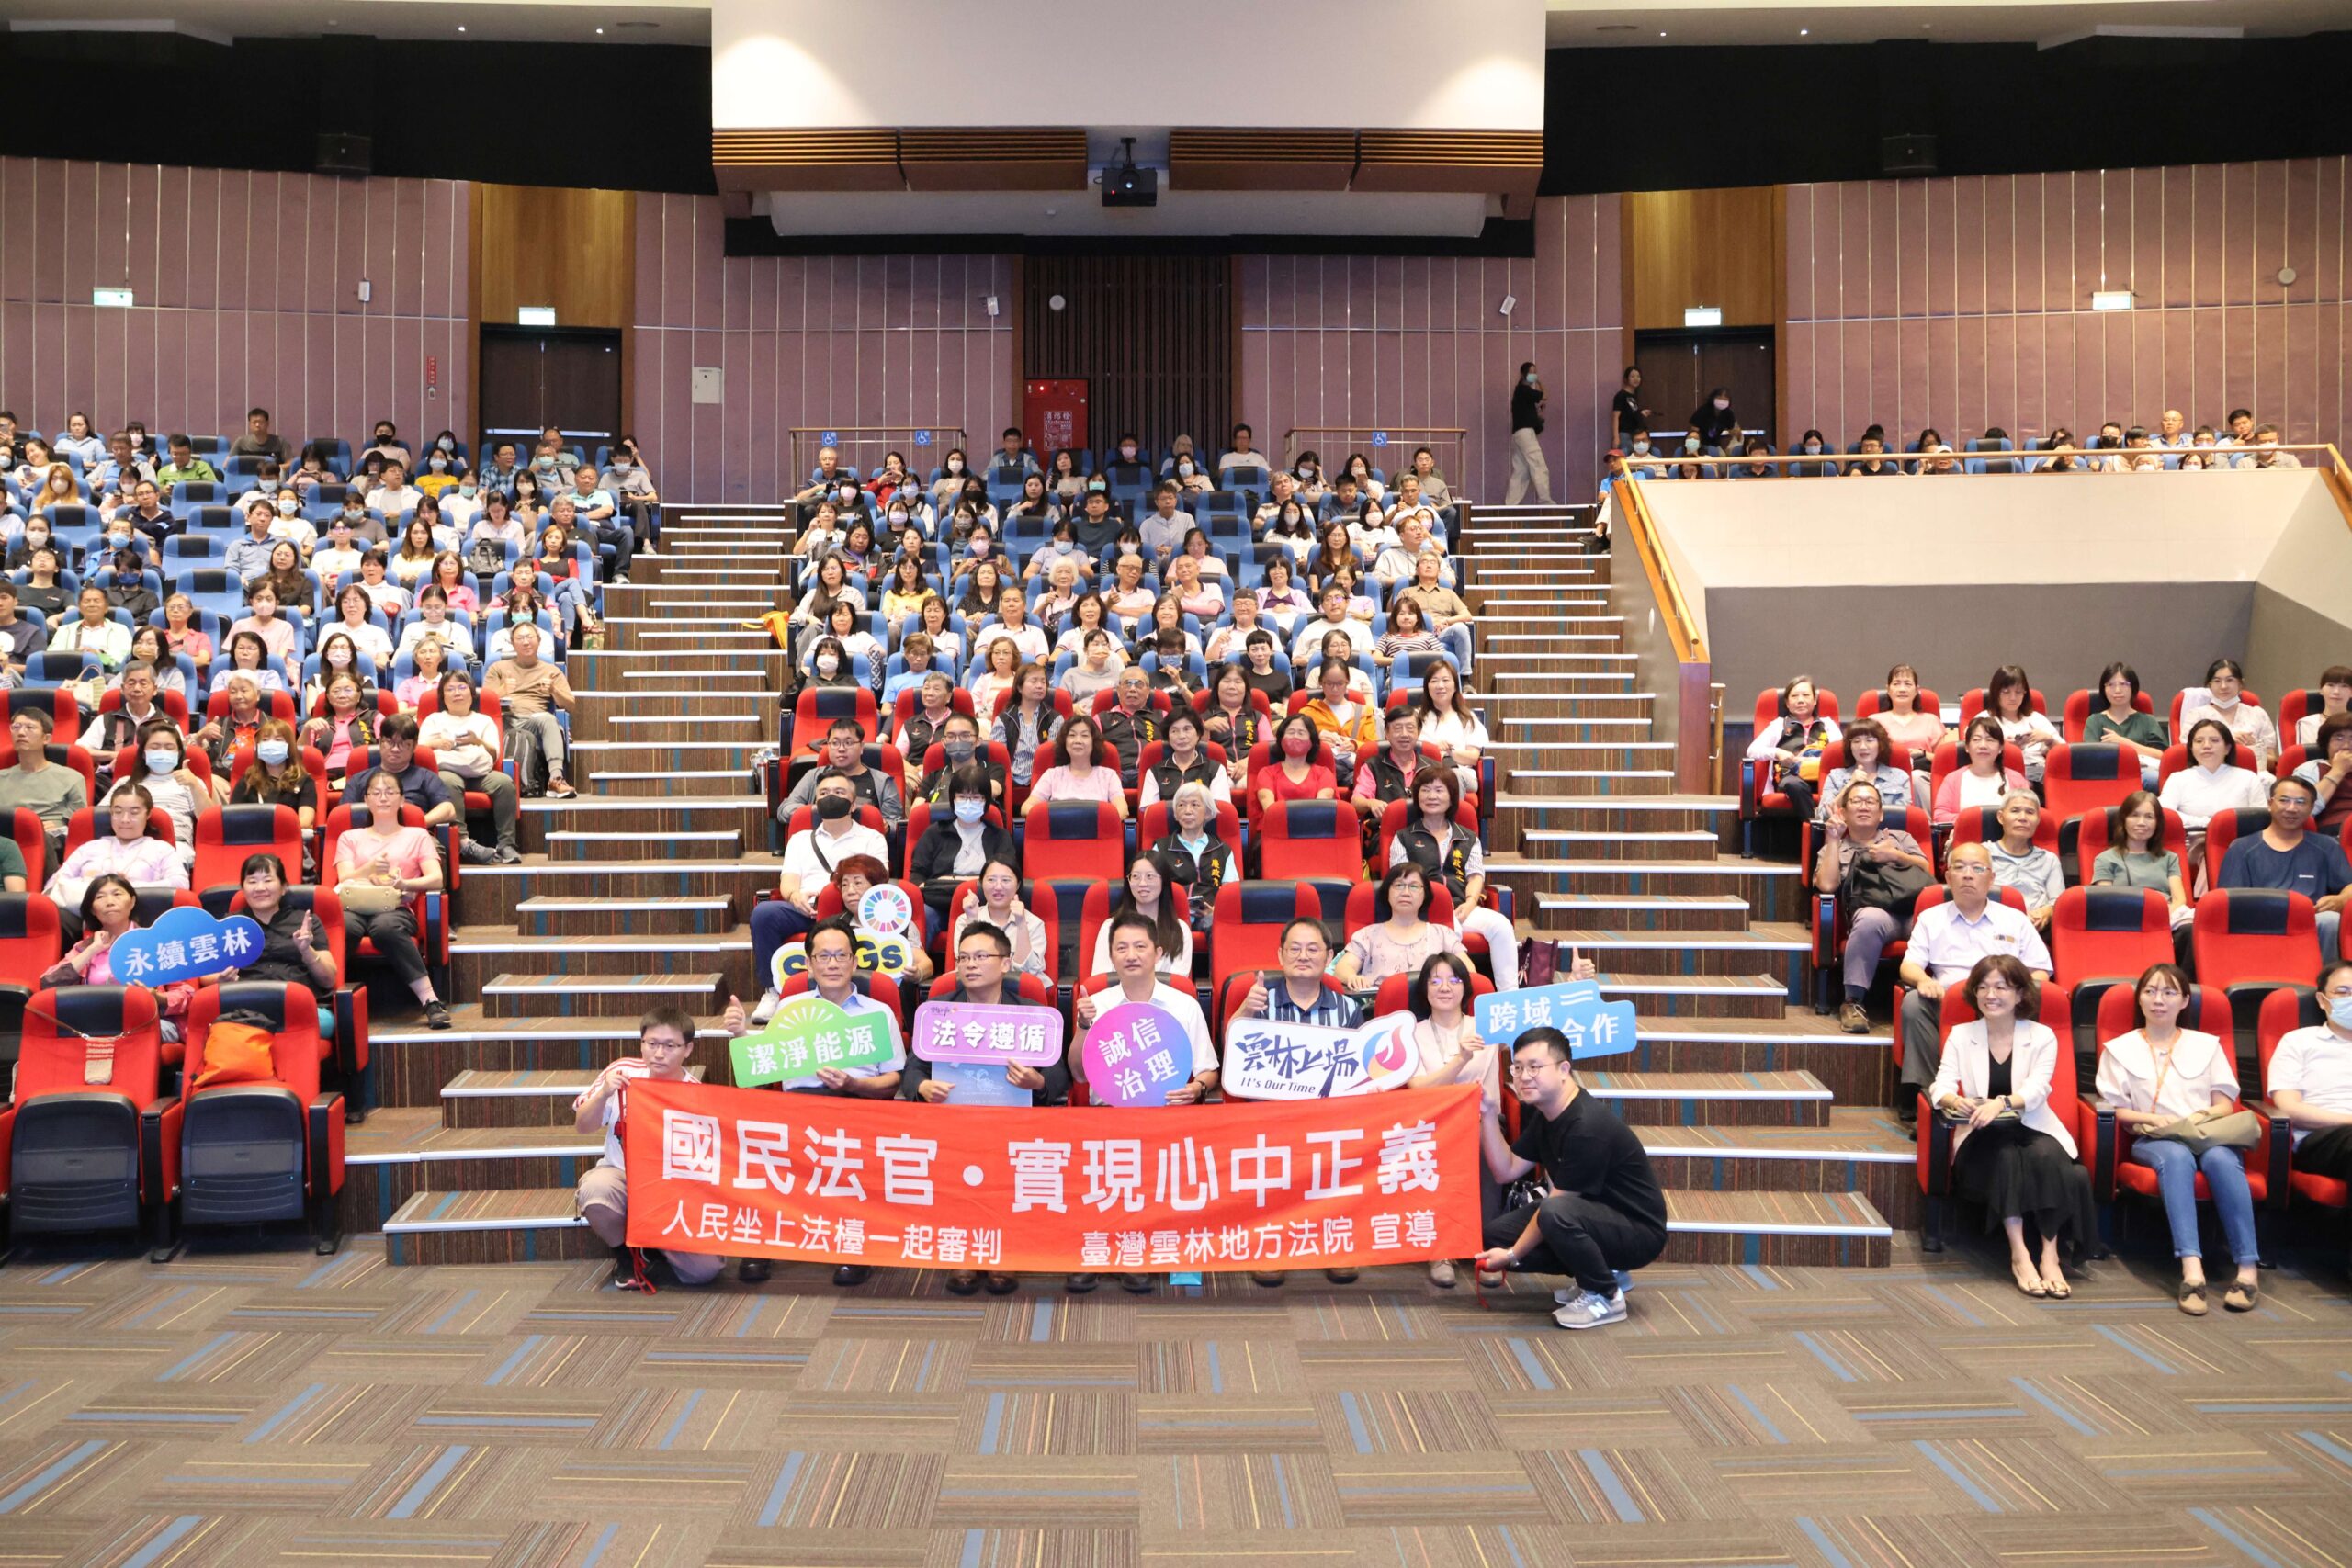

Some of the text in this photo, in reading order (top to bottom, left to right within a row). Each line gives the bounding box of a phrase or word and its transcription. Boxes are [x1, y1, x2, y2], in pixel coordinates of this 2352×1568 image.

[124, 927, 252, 976] 永續雲林
[932, 1019, 1046, 1053] 法令遵循
[1489, 997, 1553, 1034] 跨域
[1561, 1013, 1619, 1048] 合作
[747, 1025, 876, 1076] 潔淨能源
[1098, 1017, 1162, 1068] 誠信
[1114, 1049, 1179, 1101] 治理
[1241, 1077, 1316, 1094] It's Our Time
[1080, 1210, 1437, 1267] 臺灣雲林地方法院 宣導
